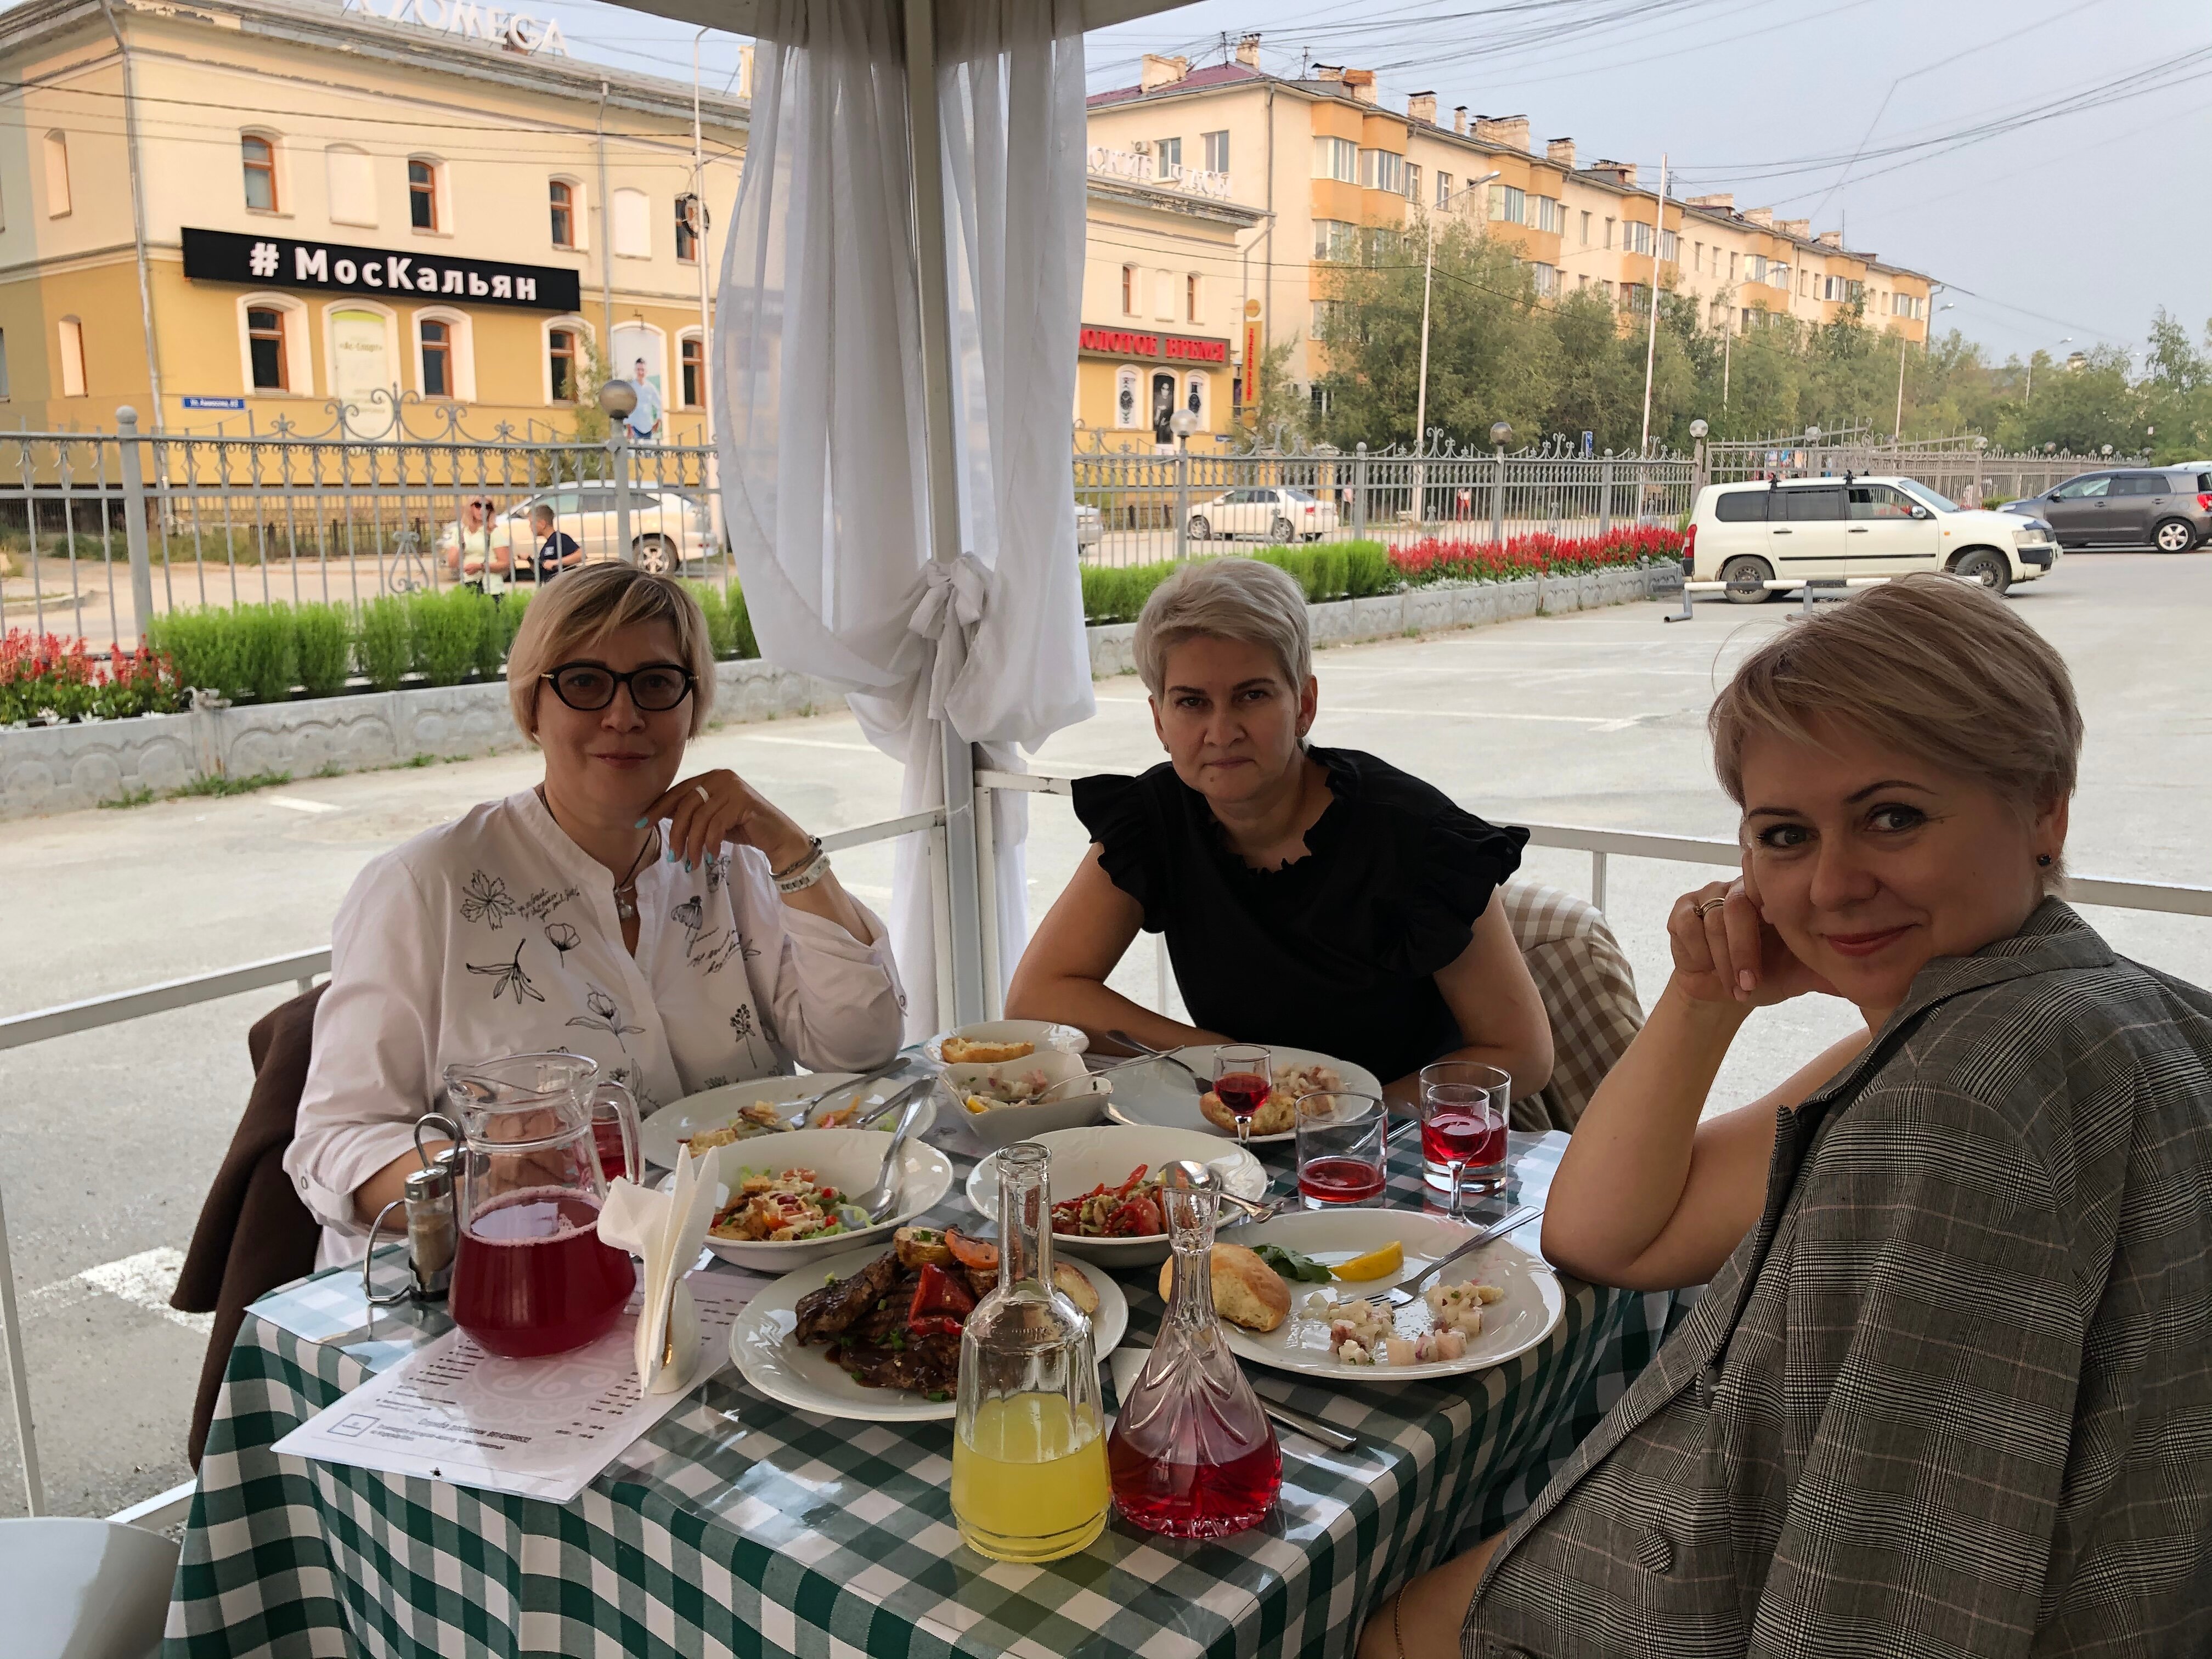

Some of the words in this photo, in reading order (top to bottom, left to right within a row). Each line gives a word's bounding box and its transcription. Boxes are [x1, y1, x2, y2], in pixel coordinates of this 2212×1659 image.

[414, 0, 569, 57] OMEGA
[1087, 146, 1152, 179] СКИЕ
[1165, 337, 1226, 362] ВРЕМЯ
